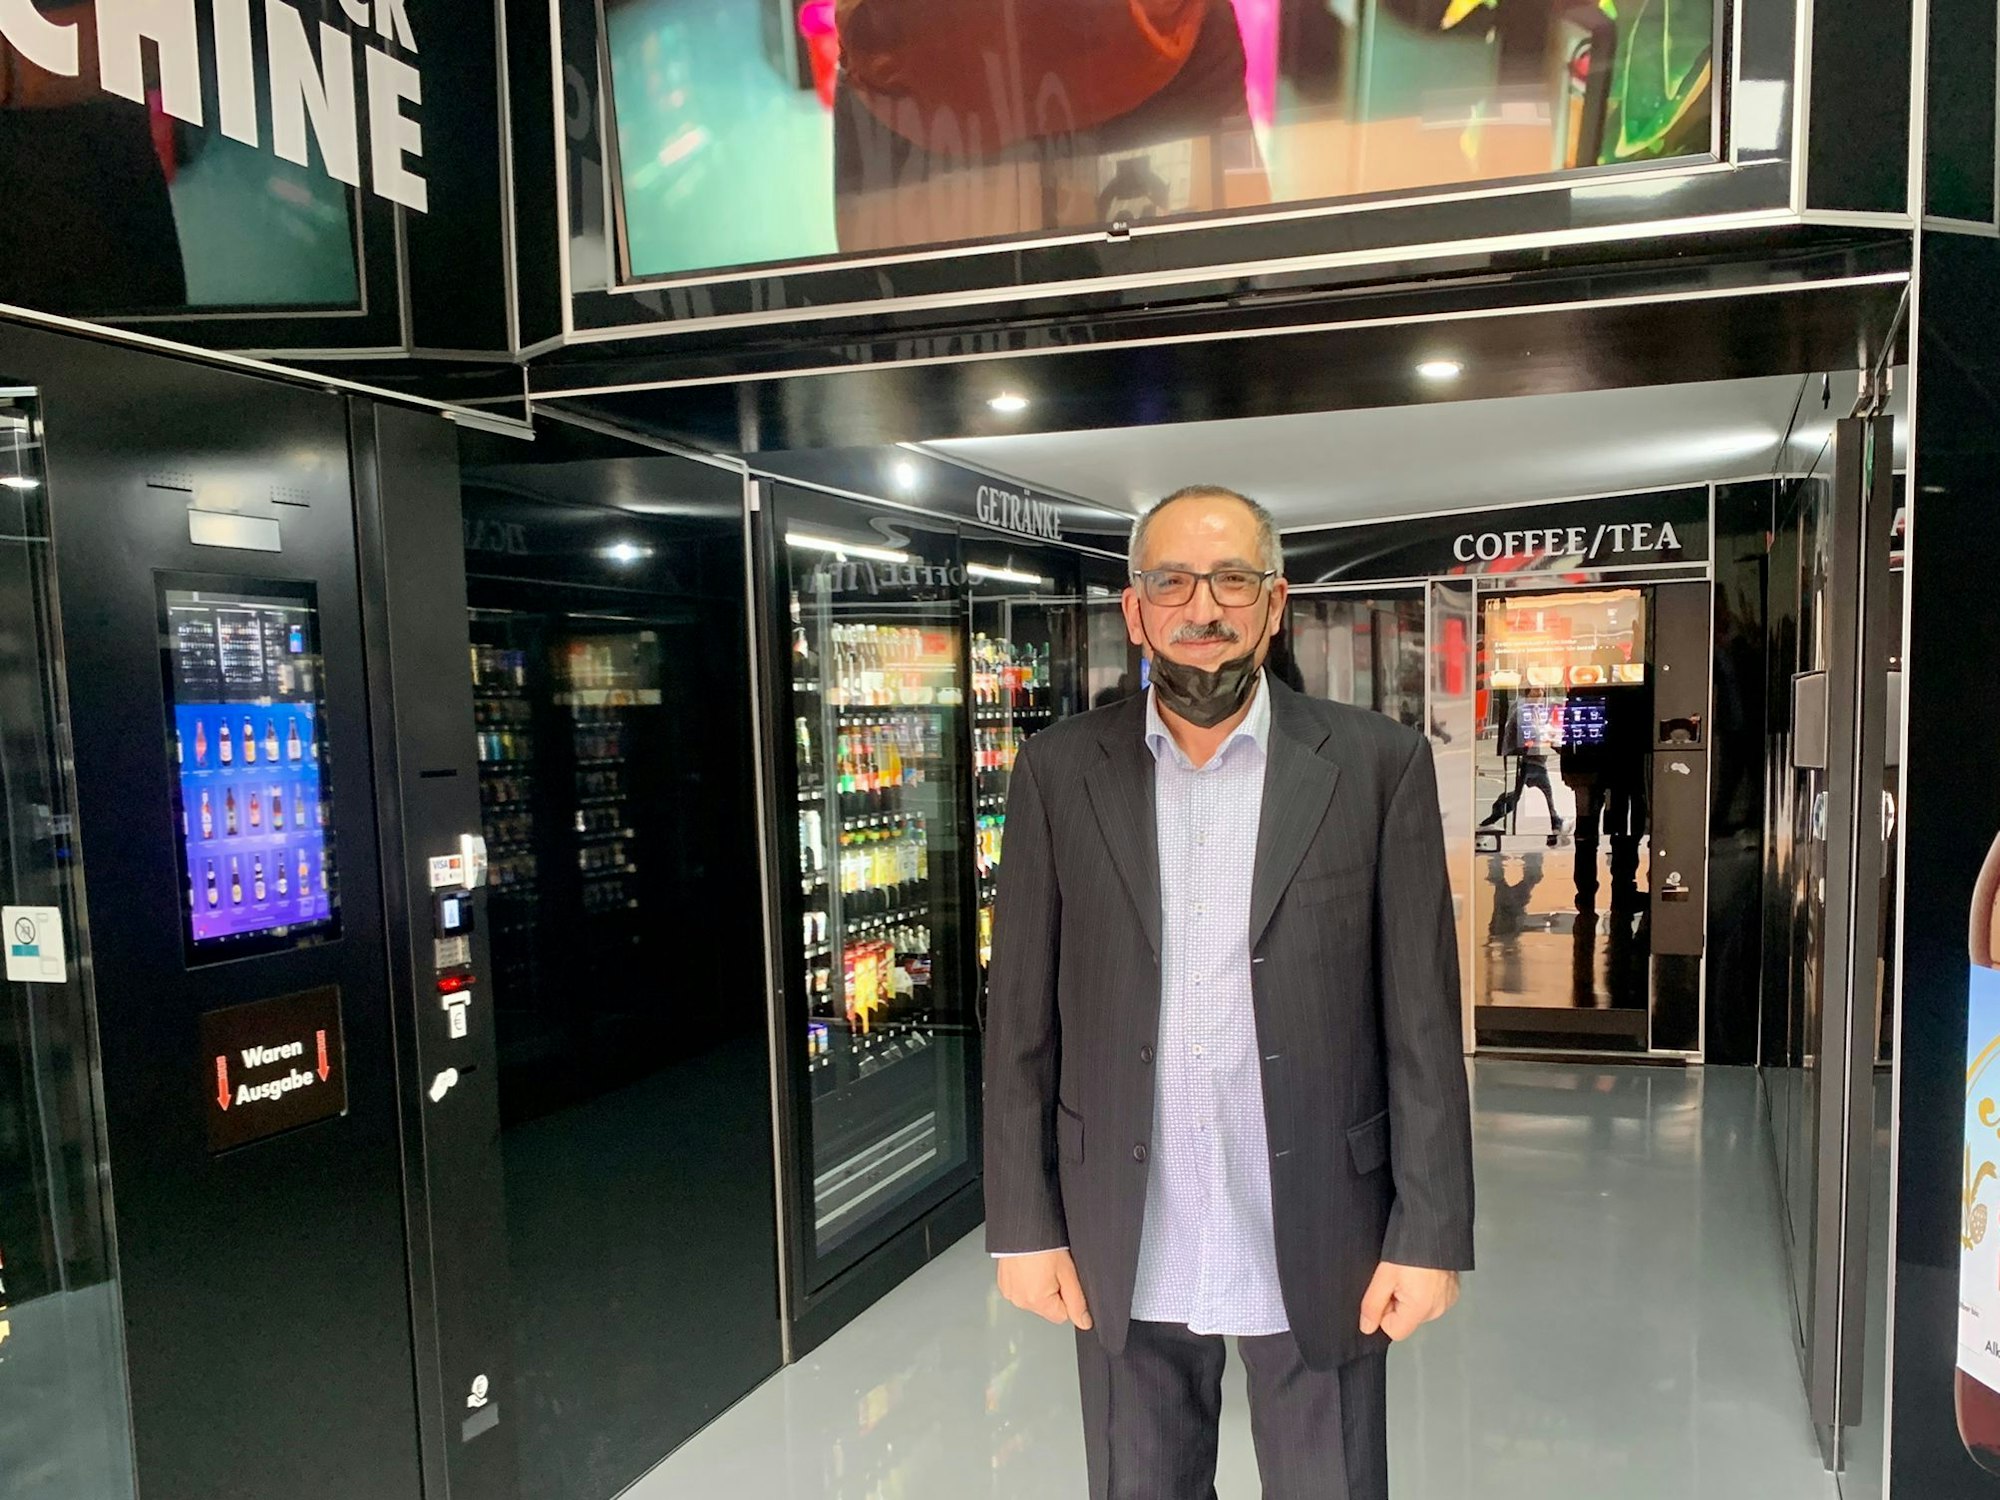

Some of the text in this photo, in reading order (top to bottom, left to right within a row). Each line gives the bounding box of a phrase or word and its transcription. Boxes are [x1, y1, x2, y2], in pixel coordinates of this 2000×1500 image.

[976, 485, 1063, 541] GETRÄNKE
[1453, 522, 1682, 562] COFFEE/TEA
[241, 1041, 303, 1069] Waren
[235, 1068, 314, 1106] Ausgabe
